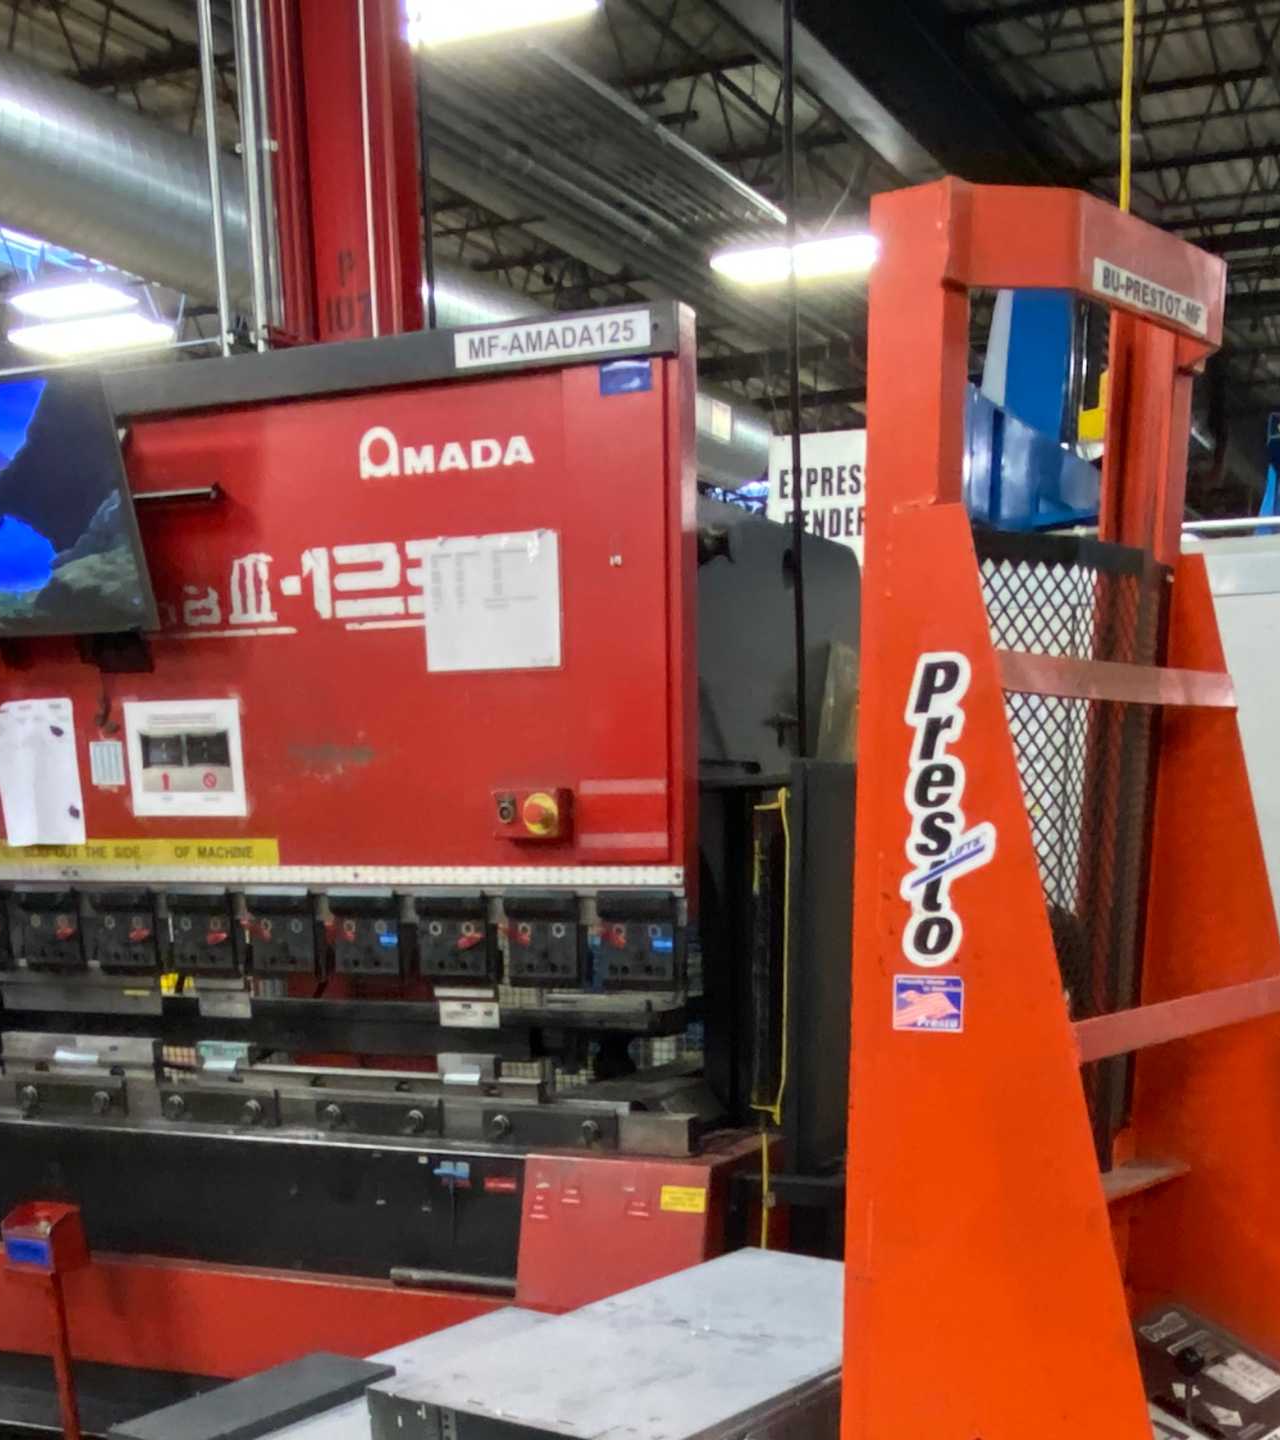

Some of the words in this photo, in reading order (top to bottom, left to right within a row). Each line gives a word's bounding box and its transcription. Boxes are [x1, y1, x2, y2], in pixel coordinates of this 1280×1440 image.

[468, 318, 635, 362] MF-AMADA125
[358, 425, 535, 480] AMADA
[913, 660, 960, 956] Presto
[174, 846, 190, 859] OF
[197, 846, 253, 859] MACHINE
